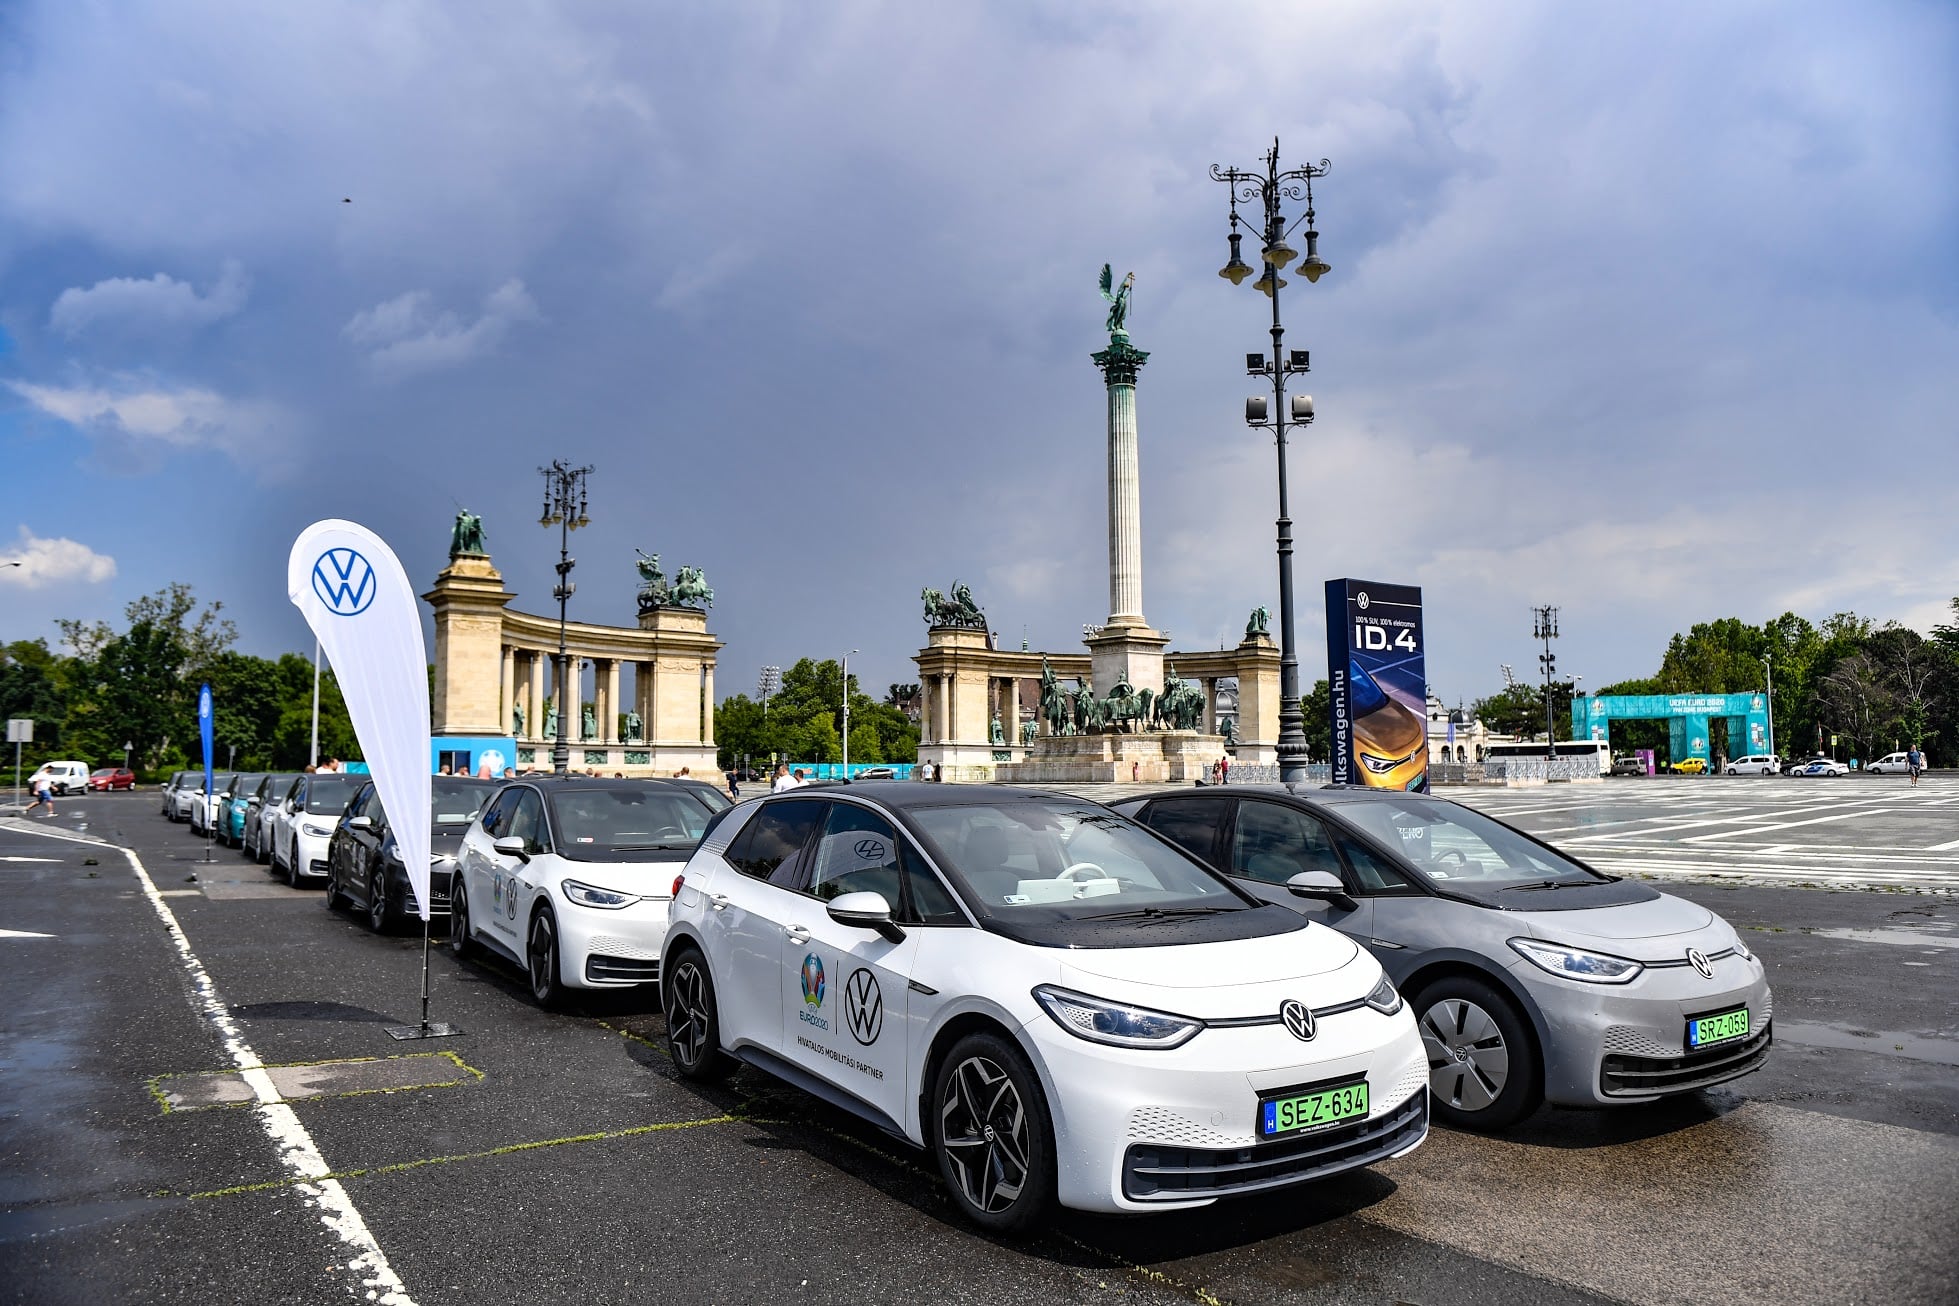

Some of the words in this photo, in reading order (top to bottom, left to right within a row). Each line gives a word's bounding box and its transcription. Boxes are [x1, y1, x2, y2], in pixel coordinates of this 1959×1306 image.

[313, 549, 375, 613] VW
[1357, 592, 1369, 609] VW
[1355, 624, 1417, 653] ID.4
[1689, 949, 1714, 979] VW
[845, 967, 883, 1047] VW
[1282, 1000, 1317, 1041] VW
[1699, 1013, 1746, 1041] SRZ-059
[856, 1061, 884, 1081] PARTNER
[1281, 1087, 1364, 1127] SEZ-634
[1267, 1119, 1274, 1129] H
